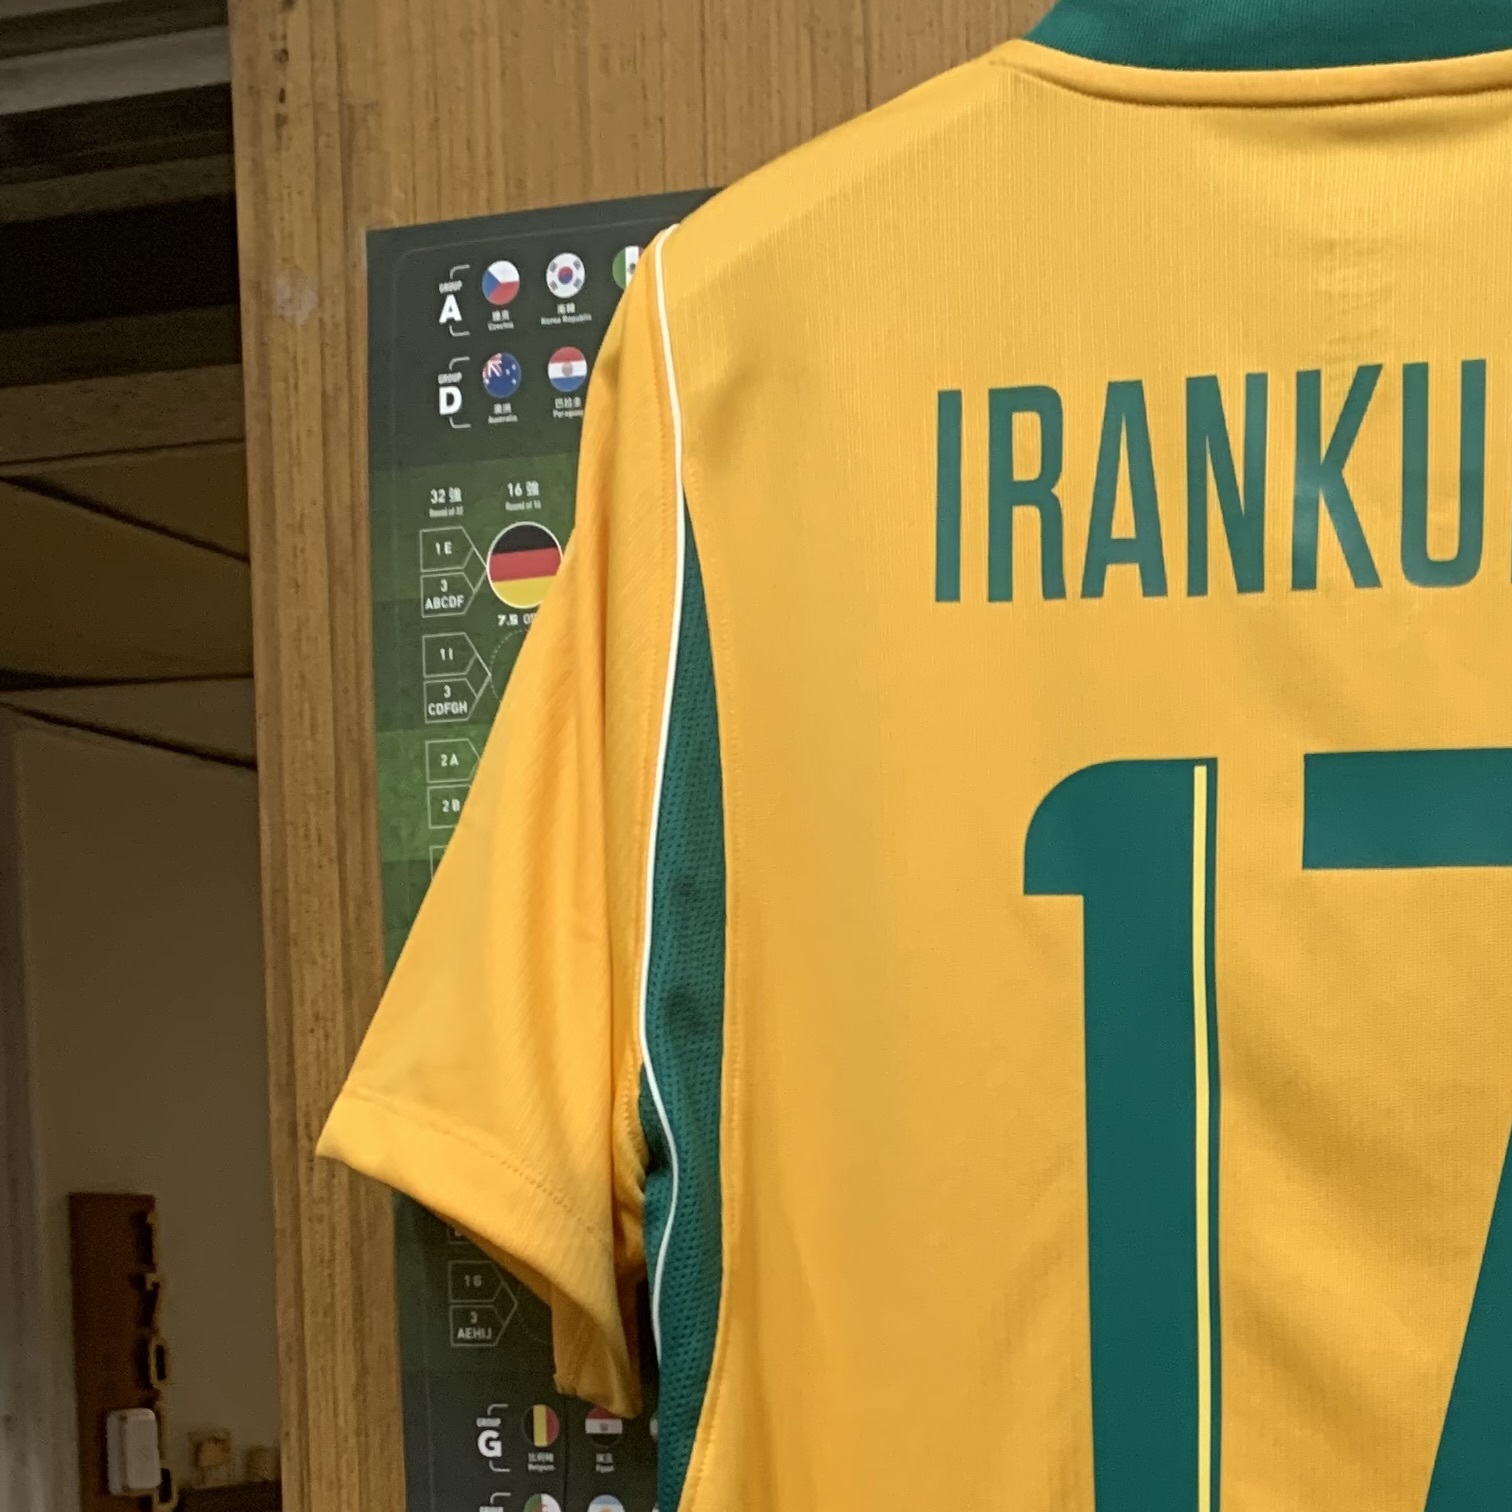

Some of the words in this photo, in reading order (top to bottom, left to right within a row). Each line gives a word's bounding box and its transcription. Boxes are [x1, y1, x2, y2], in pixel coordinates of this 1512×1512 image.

[439, 294, 462, 323] A
[438, 386, 462, 415] D
[430, 488, 446, 504] 32
[507, 482, 523, 498] 16
[440, 579, 448, 593] 3
[443, 684, 452, 699] 3
[477, 1429, 503, 1458] G
